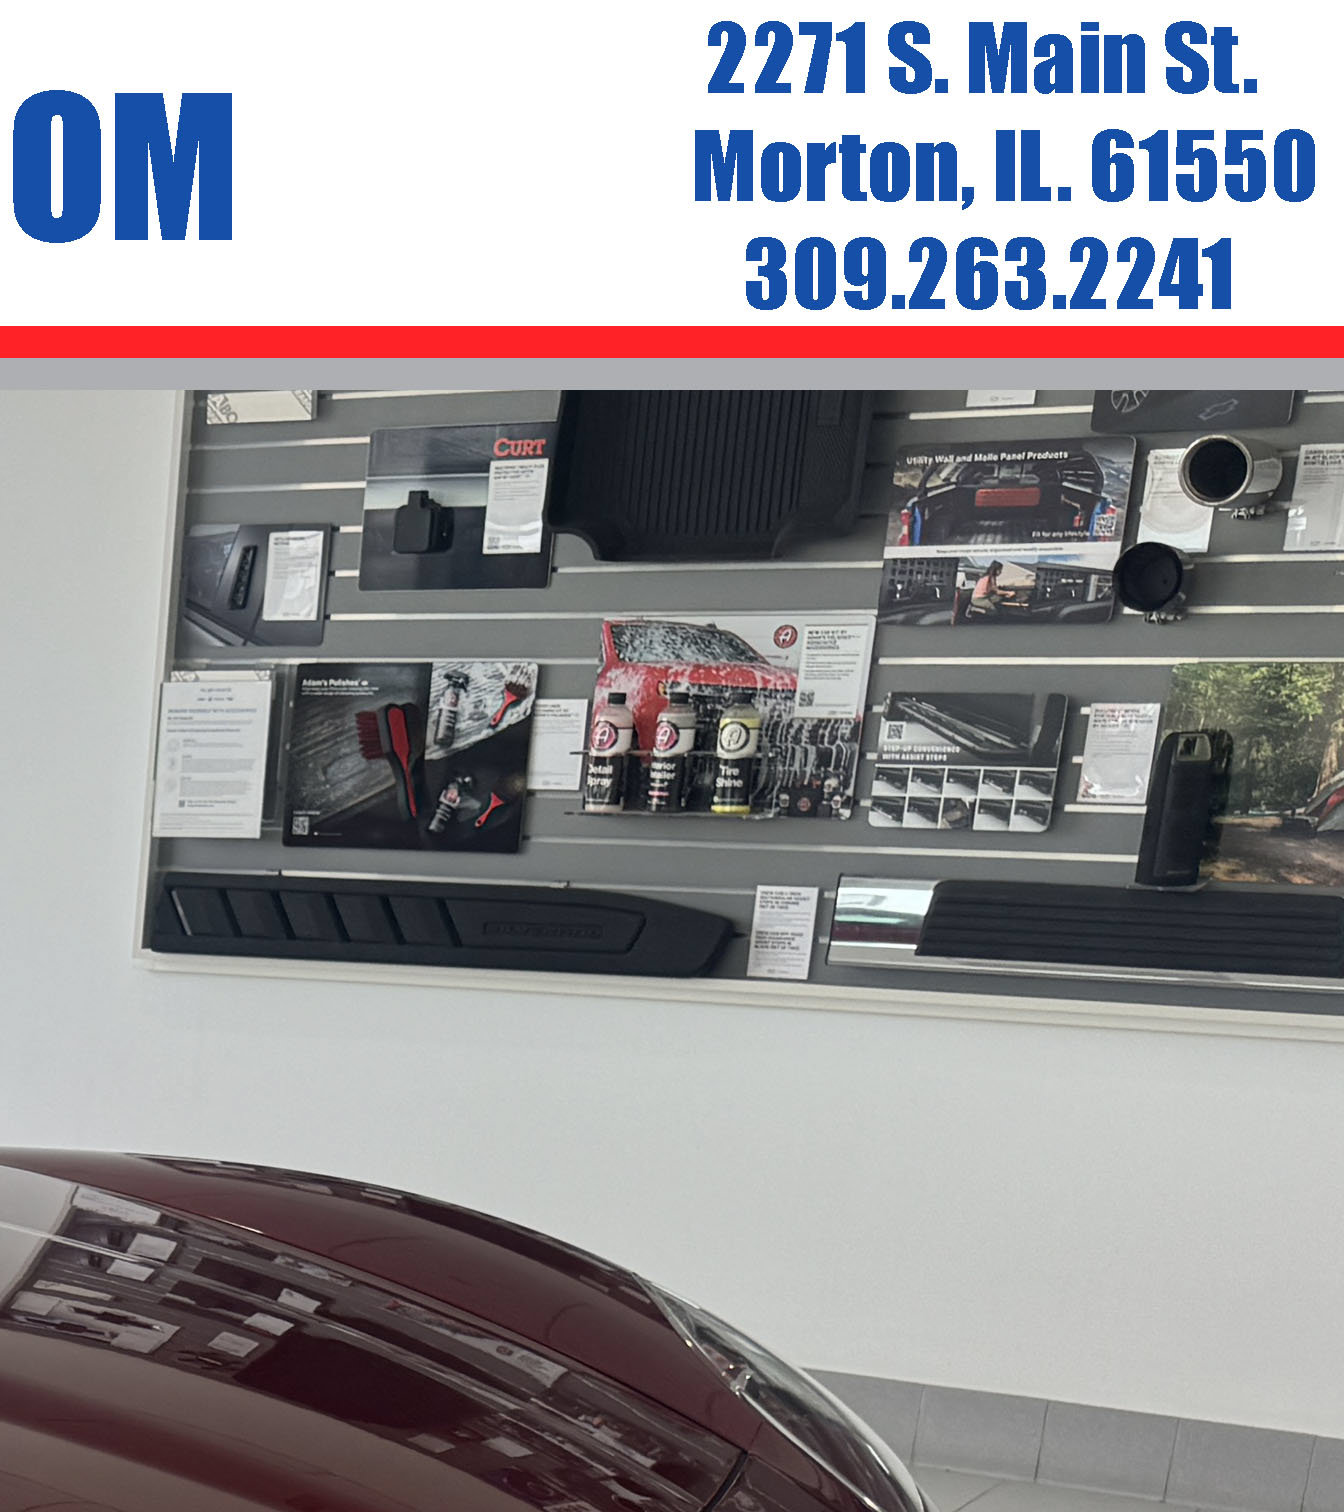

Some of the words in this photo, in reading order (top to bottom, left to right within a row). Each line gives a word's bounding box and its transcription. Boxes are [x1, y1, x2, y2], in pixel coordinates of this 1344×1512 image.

[493, 438, 546, 457] CURT
[906, 456, 932, 466] Utility
[935, 455, 954, 463] Wall
[955, 454, 972, 463] and
[1000, 452, 1025, 461] Panel
[1027, 451, 1068, 460] Products
[719, 765, 740, 776] Tire
[715, 777, 743, 788] Shine
